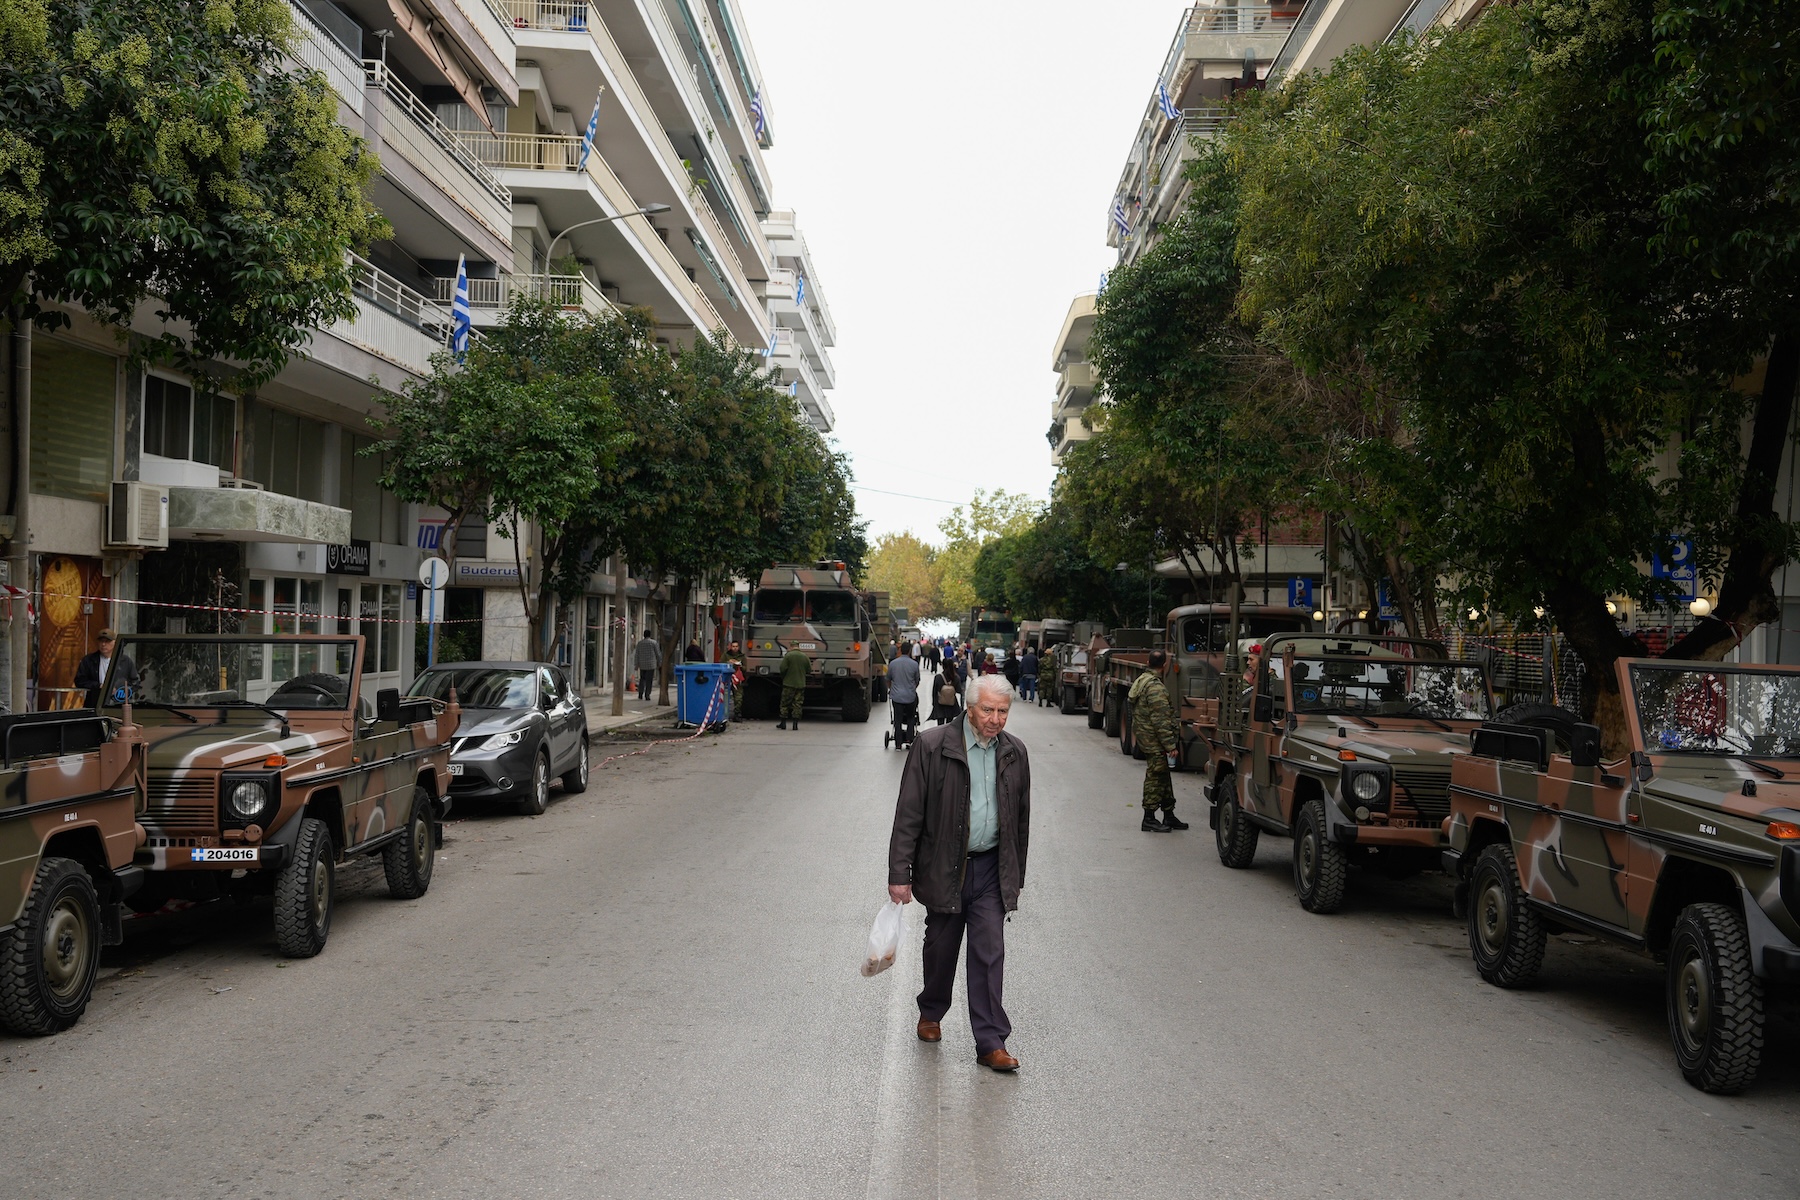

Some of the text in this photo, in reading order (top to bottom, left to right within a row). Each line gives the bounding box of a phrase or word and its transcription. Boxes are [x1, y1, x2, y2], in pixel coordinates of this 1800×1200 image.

[341, 545, 368, 565] ORAMA
[461, 566, 520, 575] Buderus
[1296, 580, 1304, 596] P
[207, 850, 253, 859] 204016
